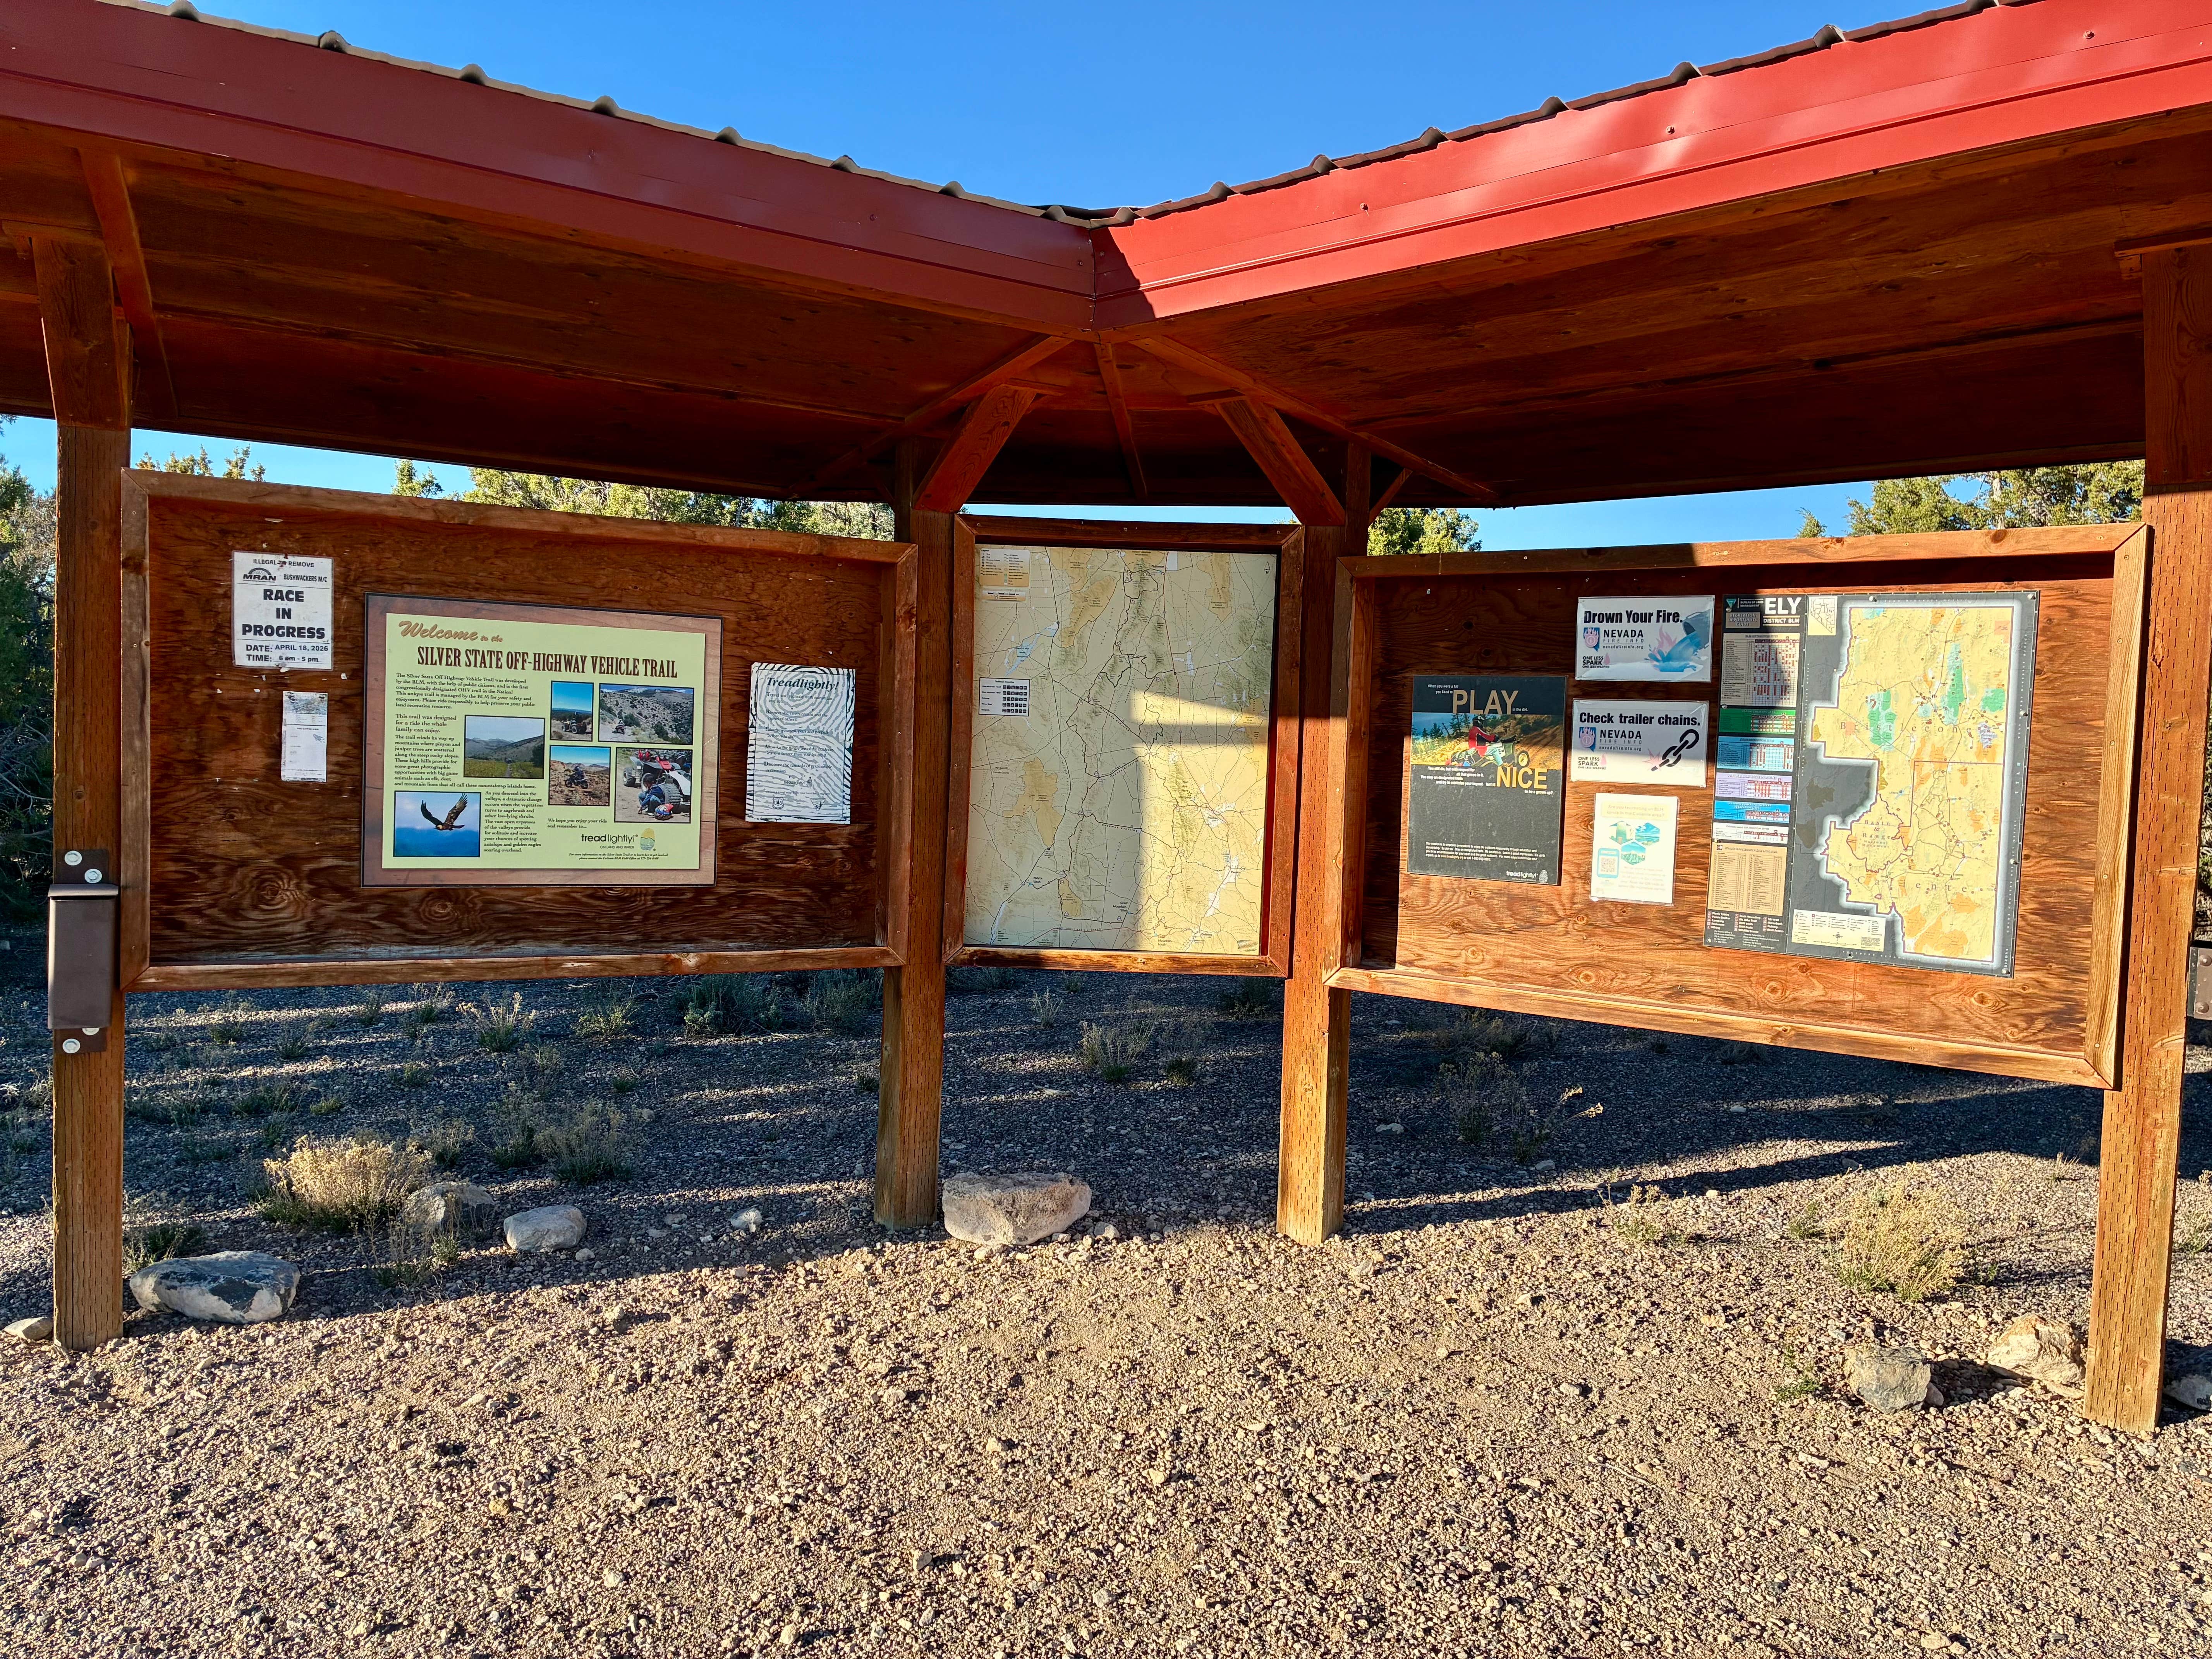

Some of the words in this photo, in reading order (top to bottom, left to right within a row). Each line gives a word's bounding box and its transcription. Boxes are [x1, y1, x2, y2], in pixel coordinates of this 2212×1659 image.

[263, 589, 304, 602] RACE
[1765, 597, 1802, 614] ELY
[276, 608, 292, 619] IN
[1584, 610, 1623, 623] Drown
[1625, 610, 1654, 623] Your
[1656, 610, 1683, 623] Fire.
[242, 624, 325, 639] PROGRESS
[398, 620, 478, 641] Welcome
[1604, 630, 1644, 638] NEVADA
[417, 646, 461, 667] SILVER
[465, 649, 503, 669] STATE
[506, 651, 587, 674] OFF-HIGHWAY
[590, 656, 639, 676] VEHICLE
[642, 659, 677, 678] TRAIL
[766, 677, 839, 692] Treadlightly!
[1453, 690, 1518, 714] PLAY
[1580, 712, 1614, 724] Check
[1619, 713, 1654, 725] trailer
[1658, 714, 1700, 726] chains.
[1600, 729, 1642, 739] NEVADA
[1496, 766, 1548, 789] NICE
